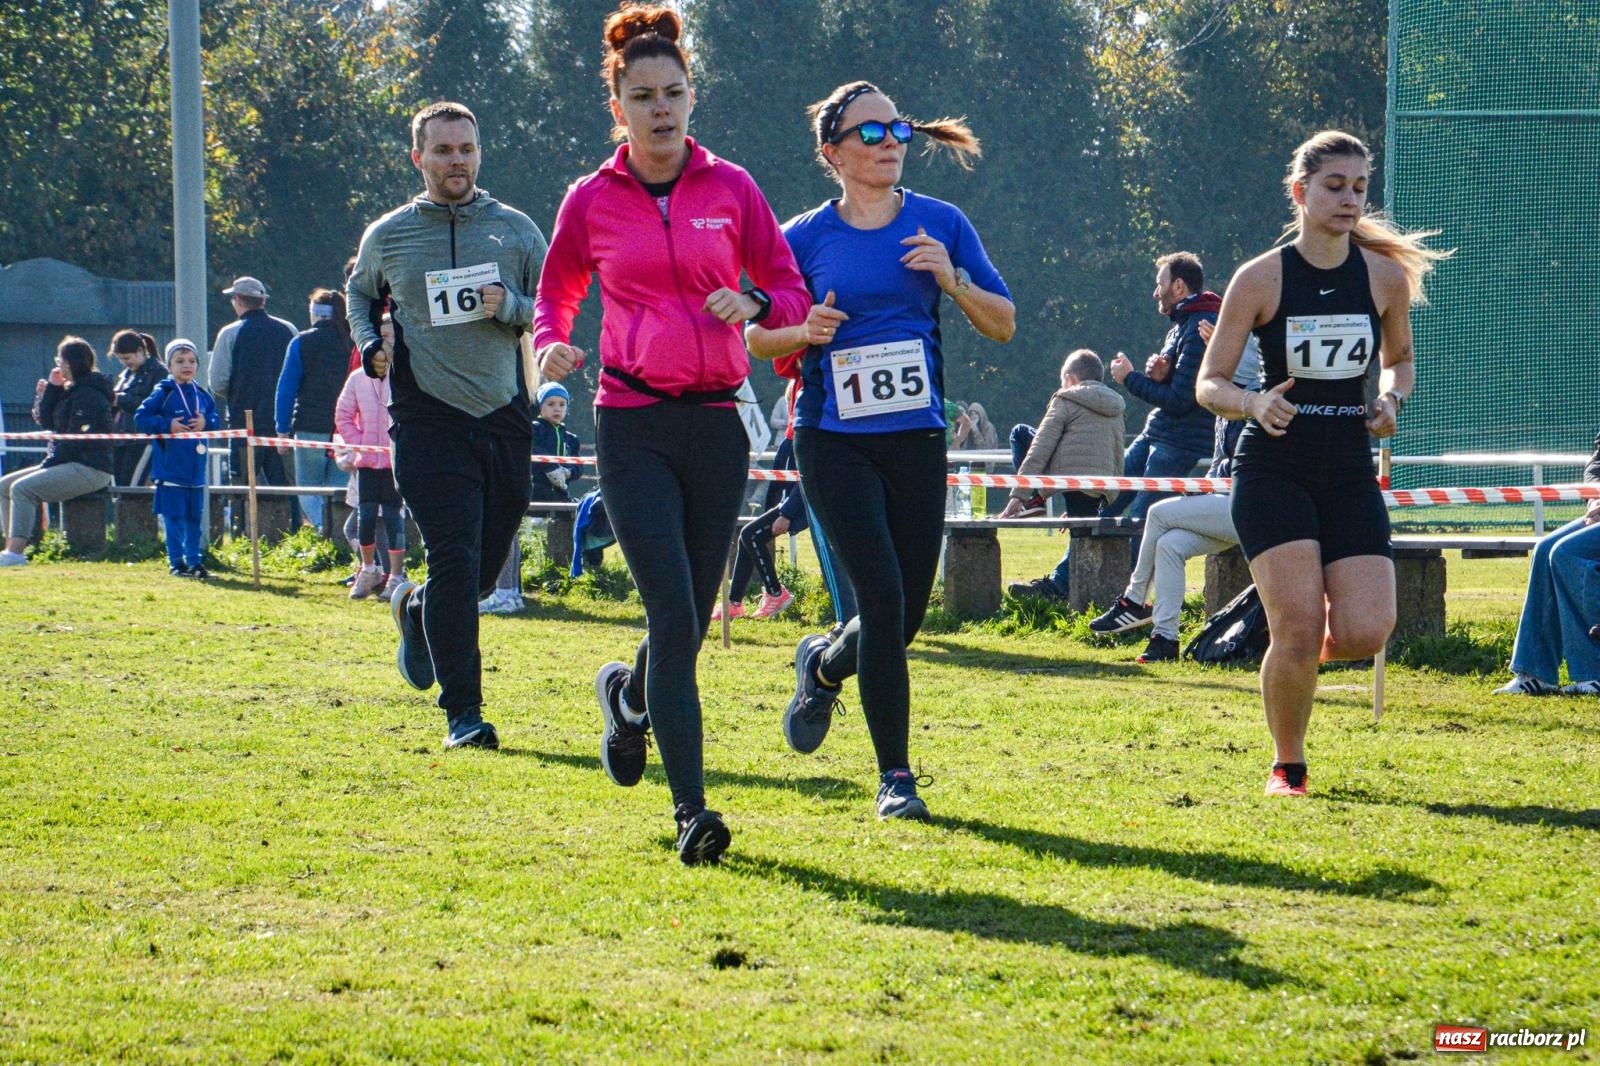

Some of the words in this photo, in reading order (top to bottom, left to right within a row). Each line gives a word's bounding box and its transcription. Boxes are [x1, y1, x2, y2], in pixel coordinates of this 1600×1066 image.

[434, 287, 485, 315] 16
[1294, 337, 1367, 367] 174
[843, 365, 924, 404] 185
[1295, 403, 1337, 415] NIKE
[1337, 405, 1364, 415] PRO
